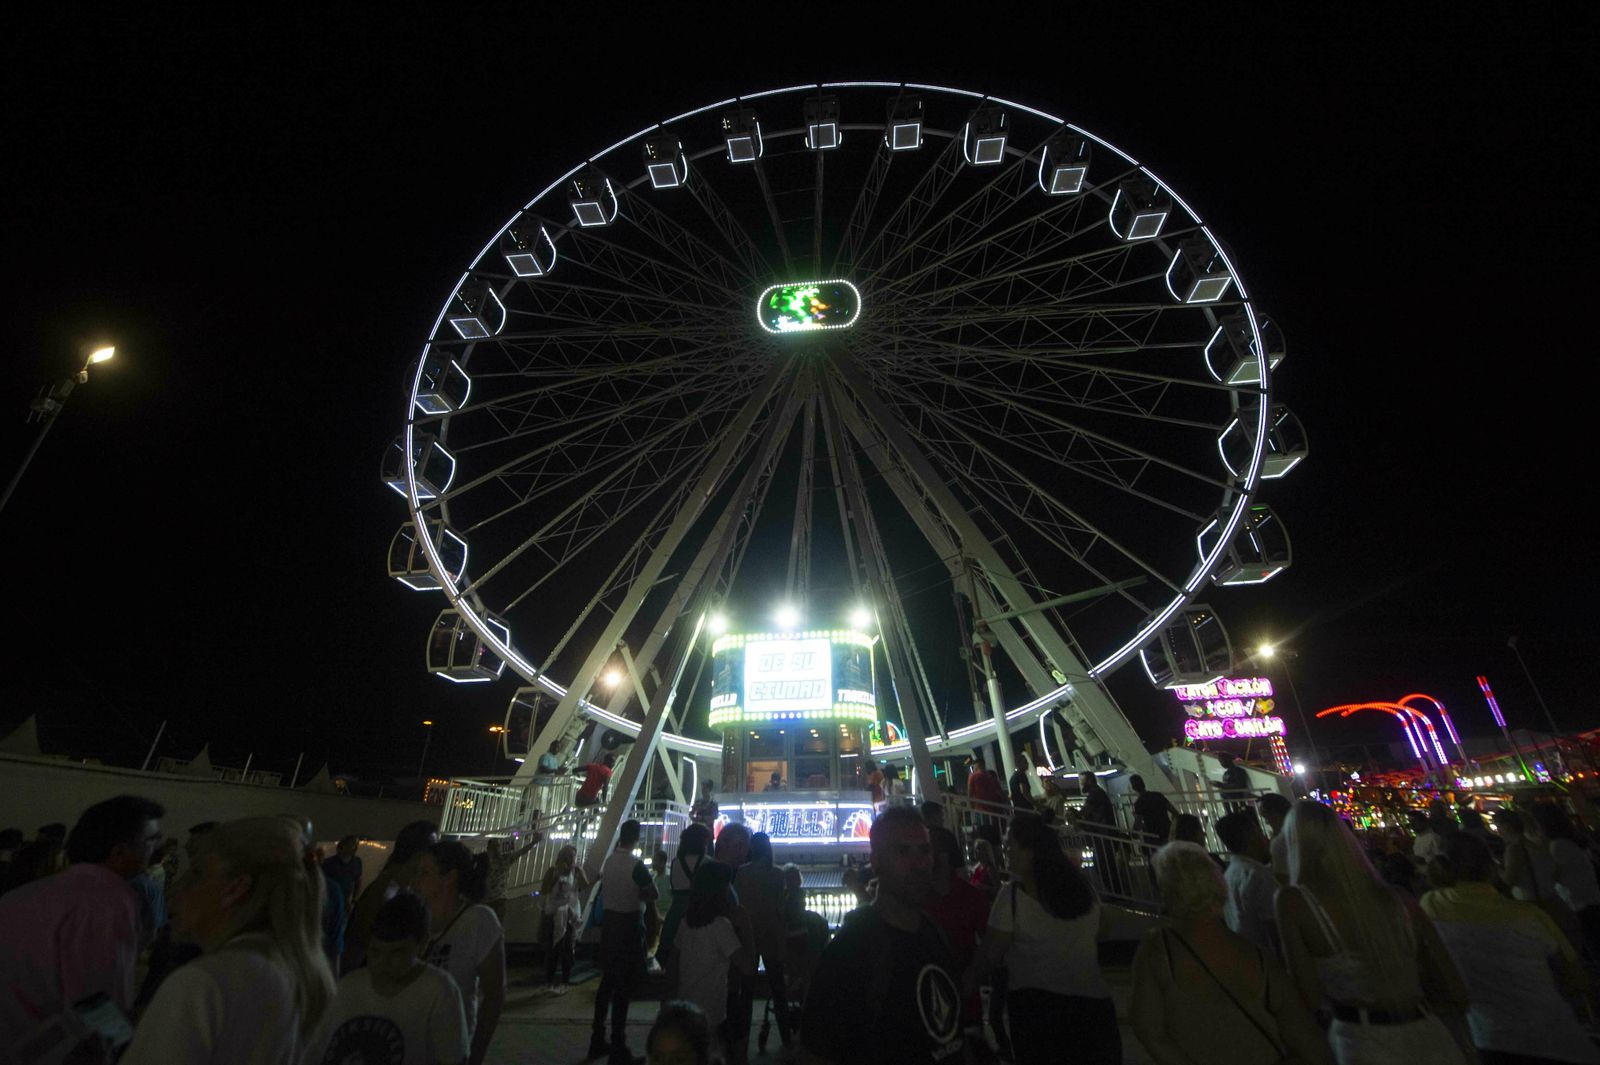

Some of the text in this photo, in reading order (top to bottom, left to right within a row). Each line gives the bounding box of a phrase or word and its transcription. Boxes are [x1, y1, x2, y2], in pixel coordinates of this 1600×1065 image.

[758, 651, 816, 672] DE SU
[749, 679, 826, 700] CIUDAD
[1215, 700, 1244, 717] CON
